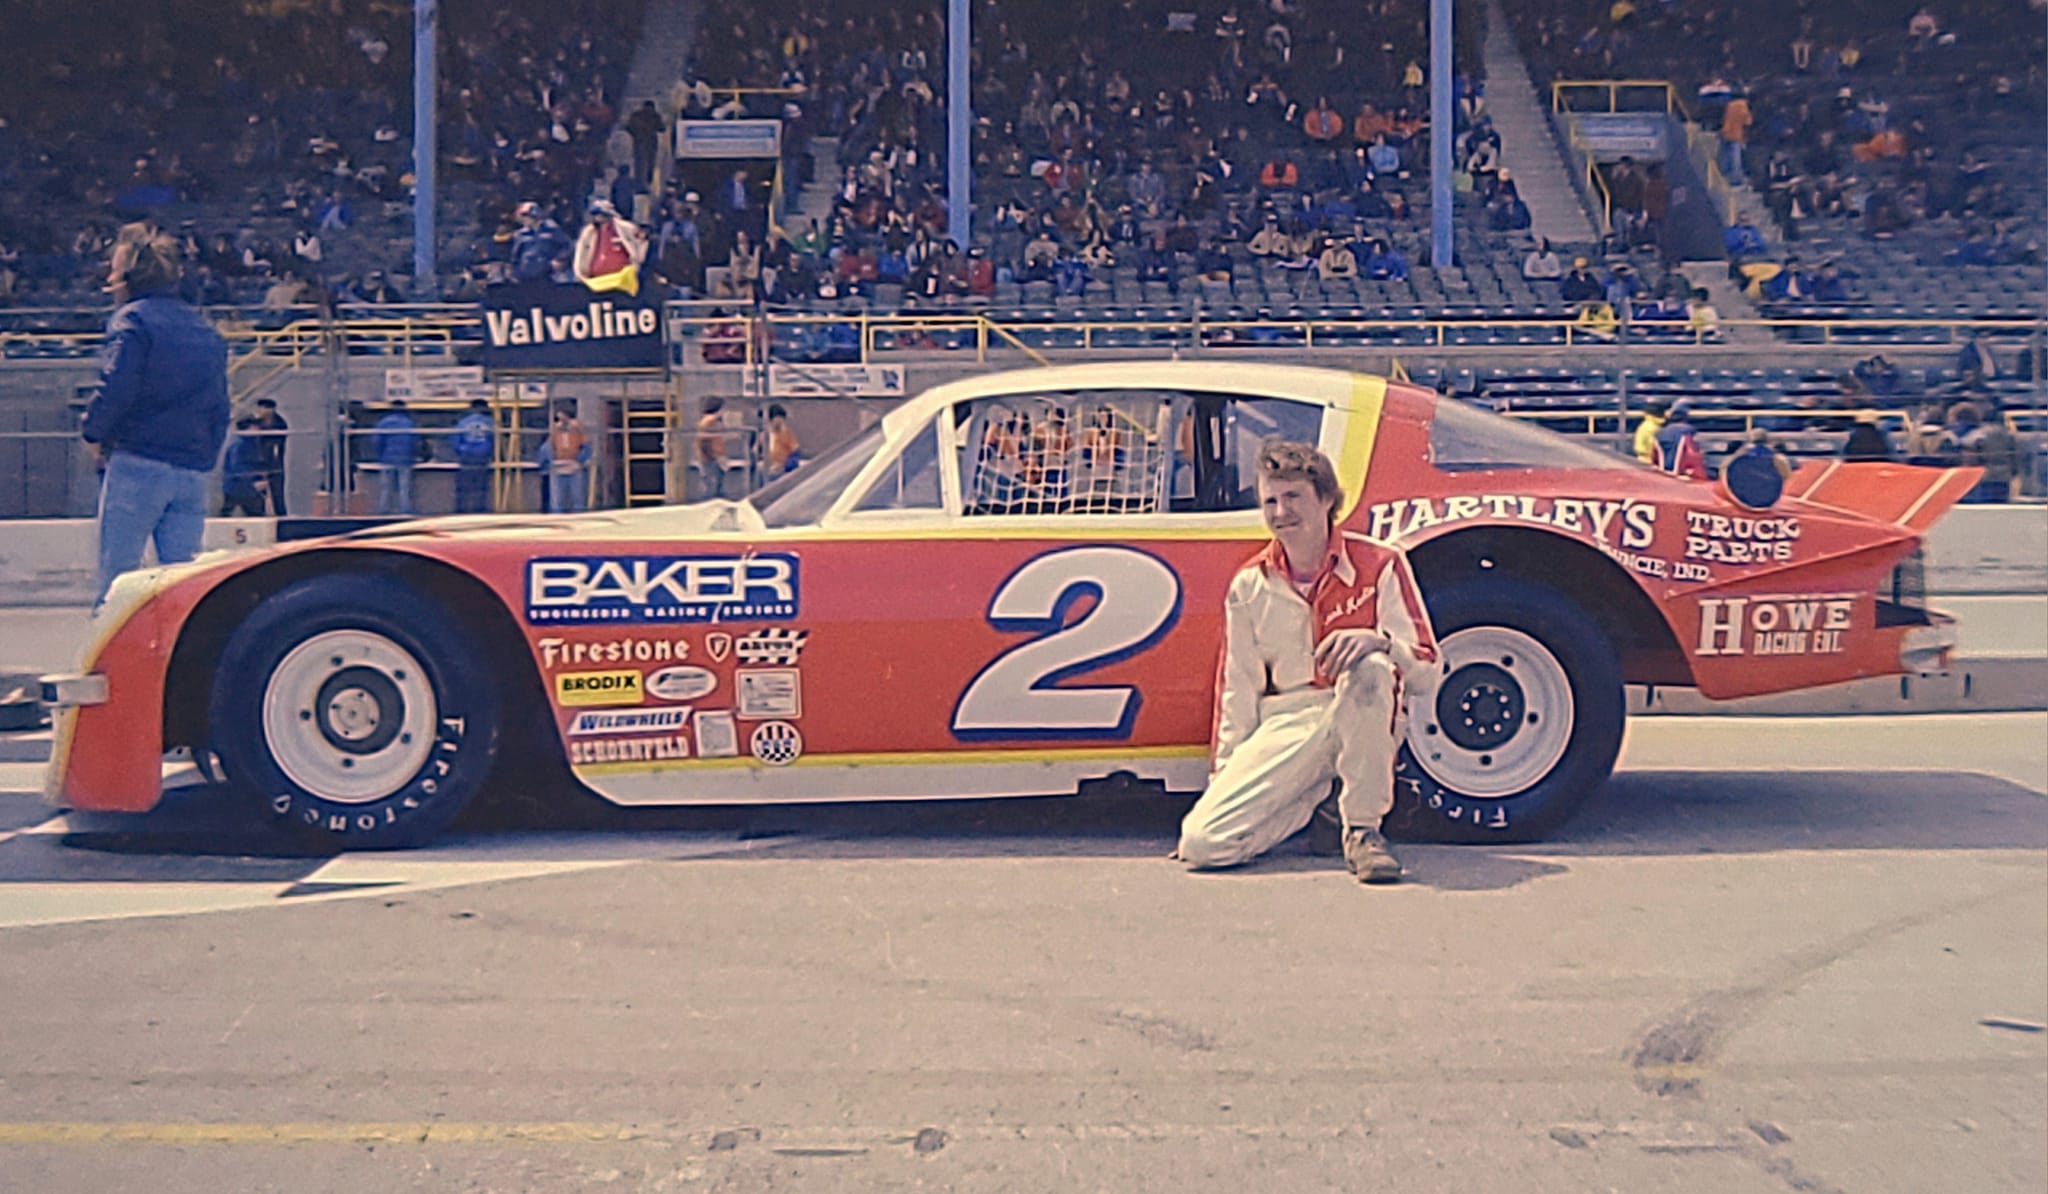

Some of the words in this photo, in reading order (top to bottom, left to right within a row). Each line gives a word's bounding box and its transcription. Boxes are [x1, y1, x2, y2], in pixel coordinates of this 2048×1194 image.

[486, 301, 657, 346] Valvoline
[1369, 495, 1656, 549] HARTLEY'S
[1686, 511, 1800, 539] TRUCK
[1684, 536, 1793, 563] PARTS
[530, 559, 794, 605] BAKER
[949, 544, 1184, 742] 2
[1694, 597, 1853, 656] HOWE
[537, 637, 690, 669] Firestone
[562, 675, 637, 691] BRODIX
